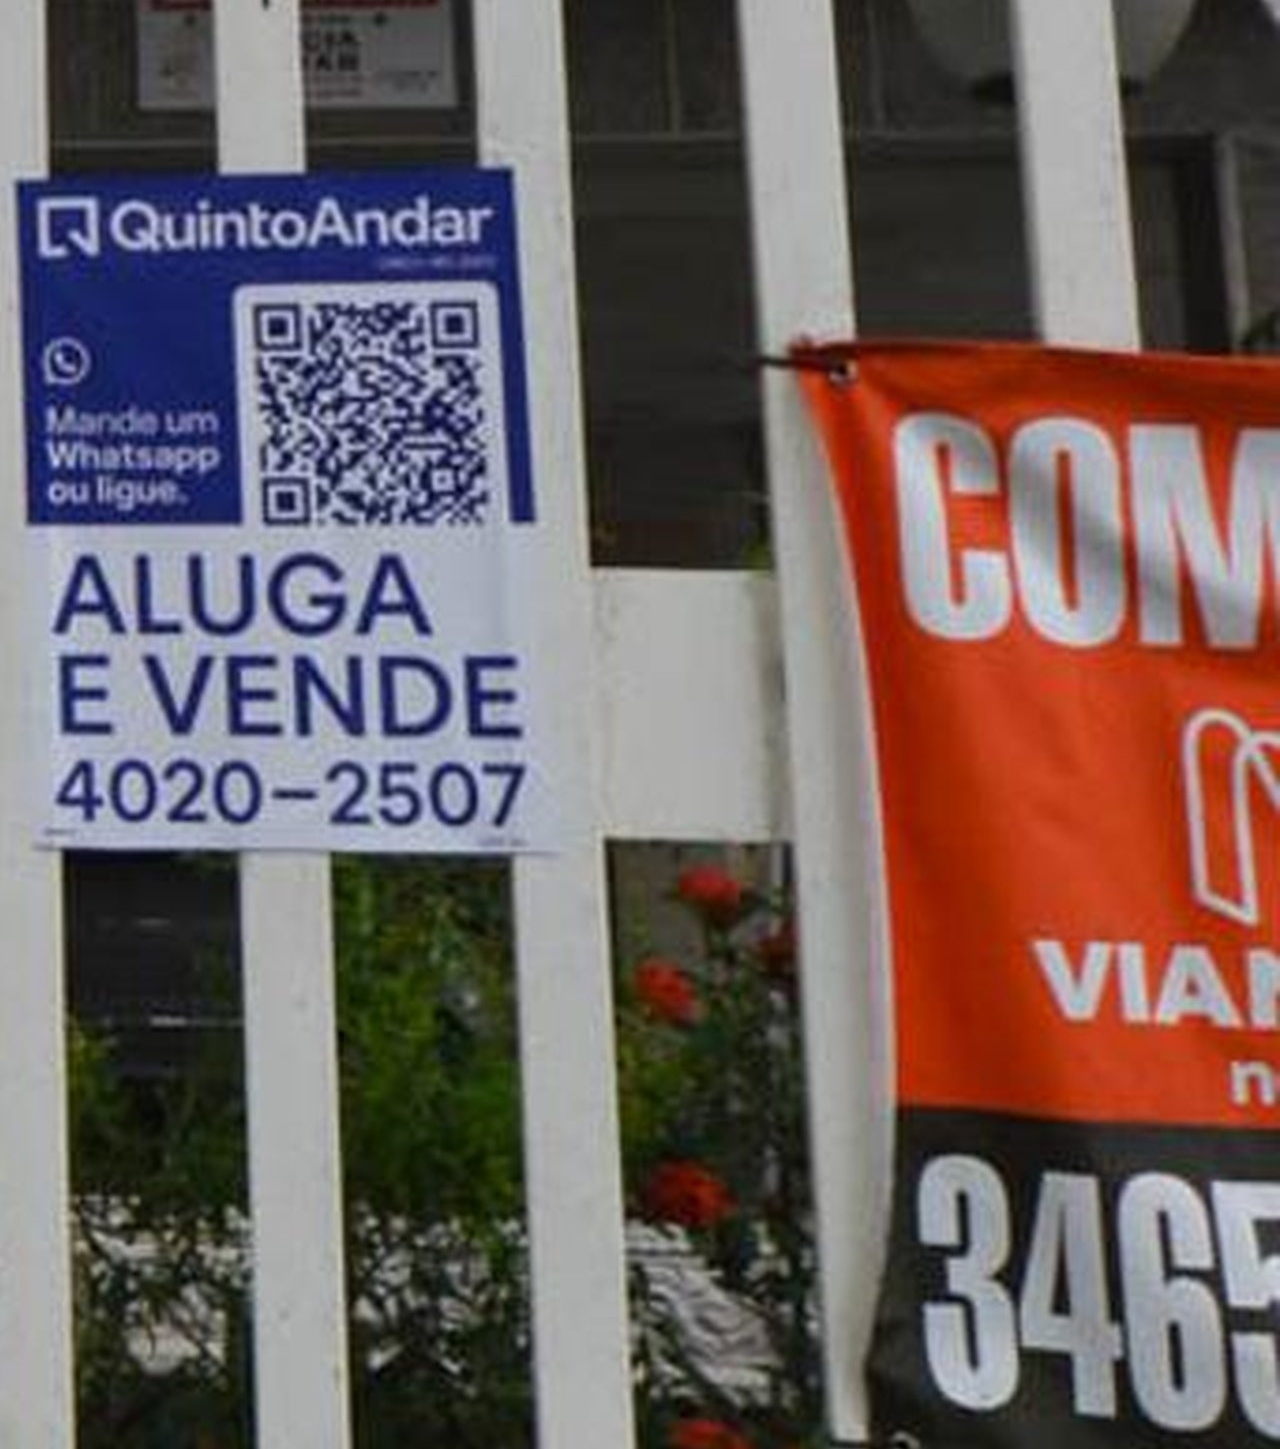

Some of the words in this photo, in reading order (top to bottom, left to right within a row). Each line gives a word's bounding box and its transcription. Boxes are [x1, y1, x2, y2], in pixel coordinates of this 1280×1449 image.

[110, 197, 494, 252] QuintoAndar
[47, 405, 160, 435] Mande
[165, 413, 220, 434] um
[47, 443, 222, 476] Whatsapp
[49, 482, 90, 505] ou
[97, 475, 190, 512] ligue.
[52, 554, 433, 636] ALUGA
[59, 655, 113, 735] E
[142, 655, 523, 738] VENDE
[56, 760, 527, 827] 4020-2507
